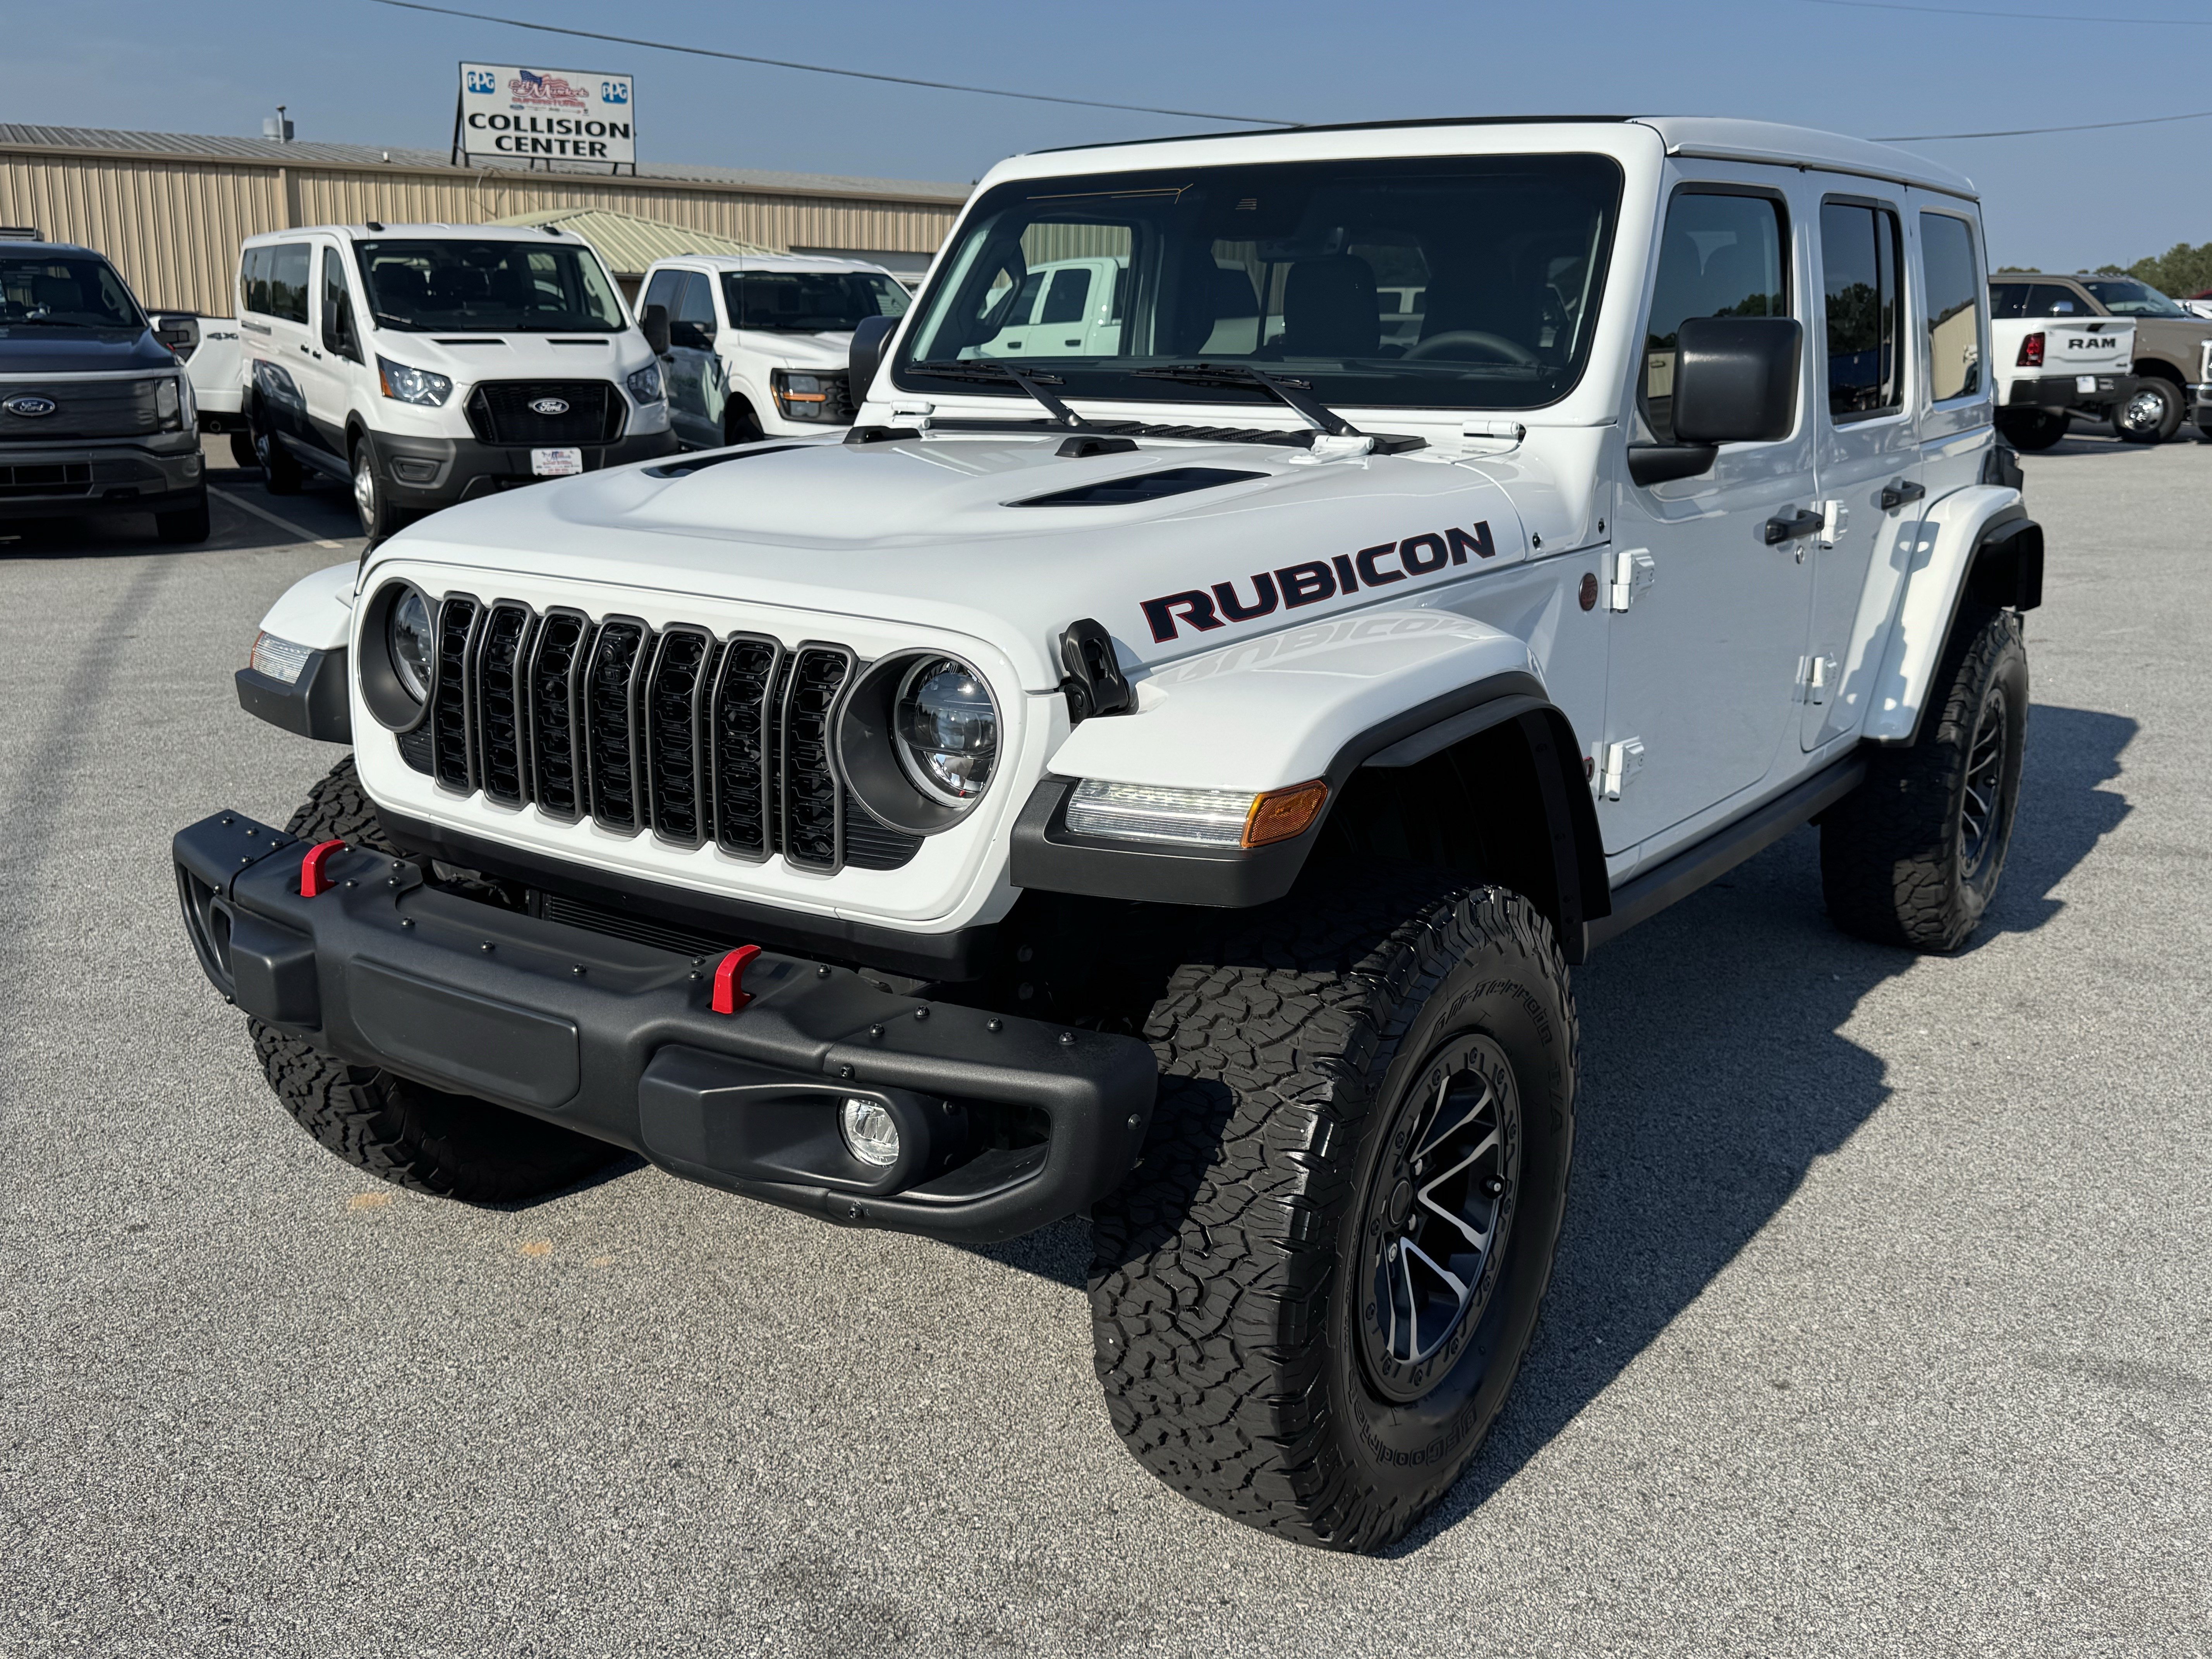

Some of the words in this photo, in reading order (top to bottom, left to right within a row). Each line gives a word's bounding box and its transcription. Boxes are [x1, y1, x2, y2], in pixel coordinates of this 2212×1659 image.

[468, 72, 494, 91] PPG
[603, 82, 627, 101] PPG
[469, 113, 630, 138] COLLISION
[495, 136, 608, 158] CENTER
[2068, 338, 2116, 349] RAM
[1139, 520, 1496, 644] RUBICON
